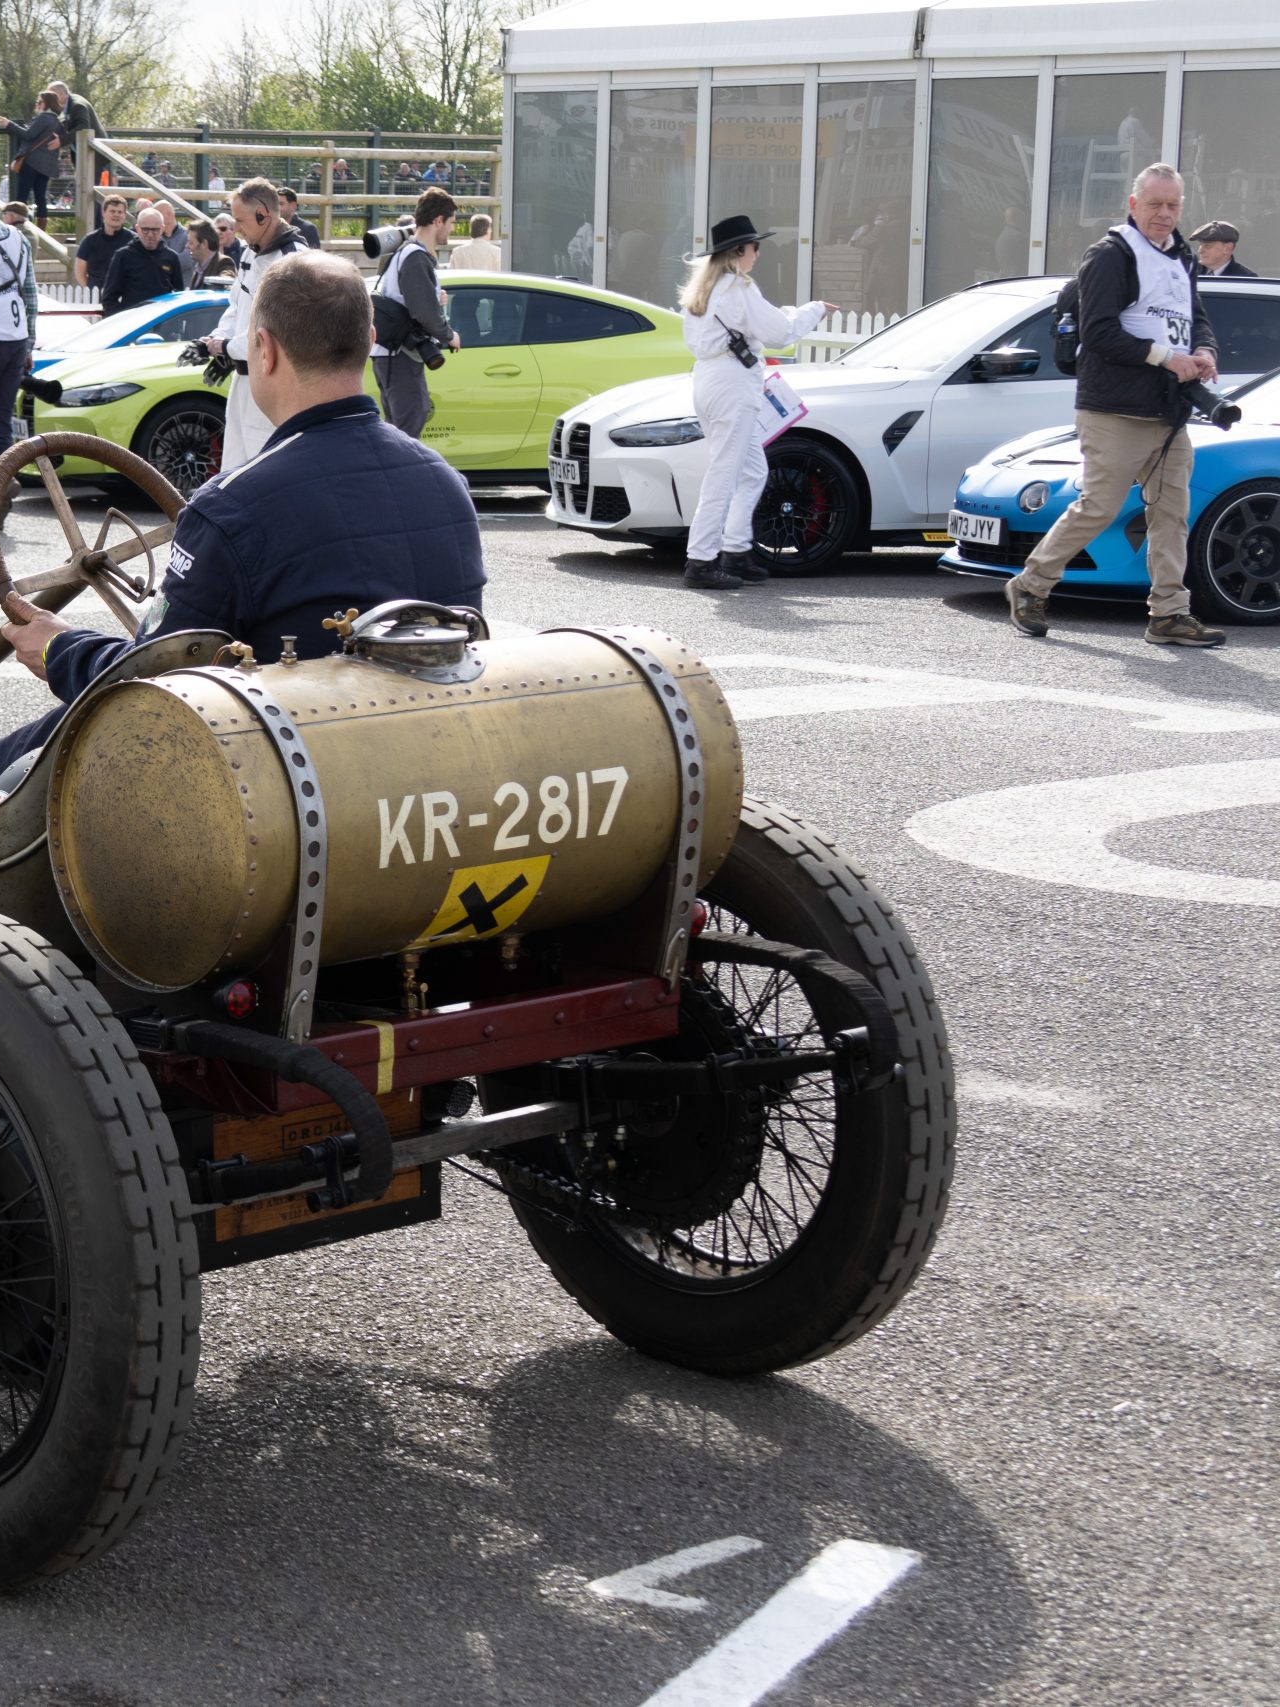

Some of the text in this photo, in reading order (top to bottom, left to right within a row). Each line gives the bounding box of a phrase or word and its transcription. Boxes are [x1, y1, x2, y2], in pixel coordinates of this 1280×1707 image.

[11, 299, 21, 328] 9
[971, 518, 995, 540] JYY
[169, 546, 193, 574] OMP
[378, 766, 630, 869] KR-2817
